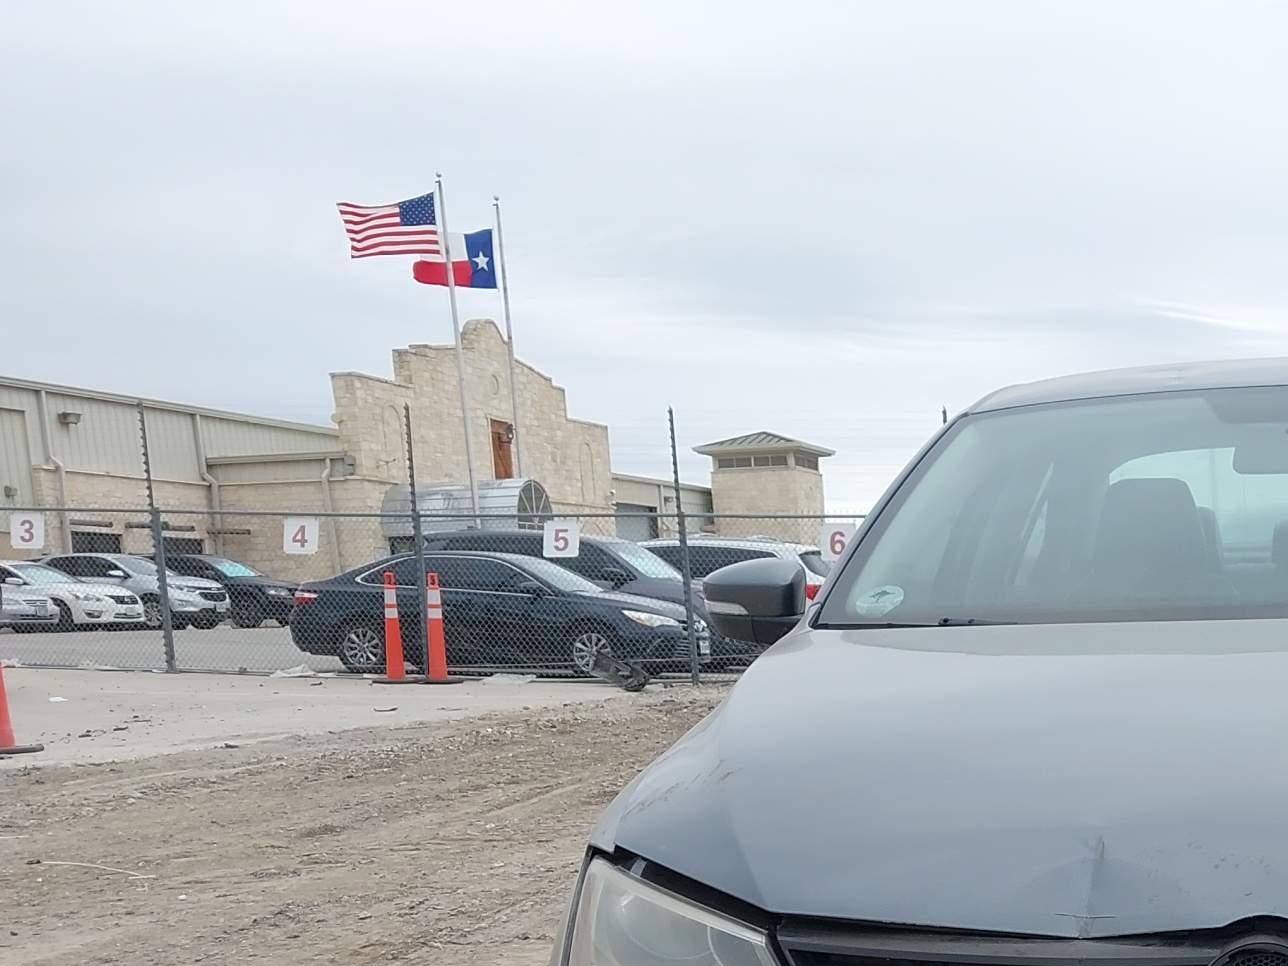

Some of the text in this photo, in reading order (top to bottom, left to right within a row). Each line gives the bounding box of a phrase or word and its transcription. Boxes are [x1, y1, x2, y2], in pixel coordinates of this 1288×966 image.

[20, 519, 34, 543] 3
[292, 525, 308, 548] 4
[553, 528, 569, 551] 5
[830, 531, 846, 555] 6
